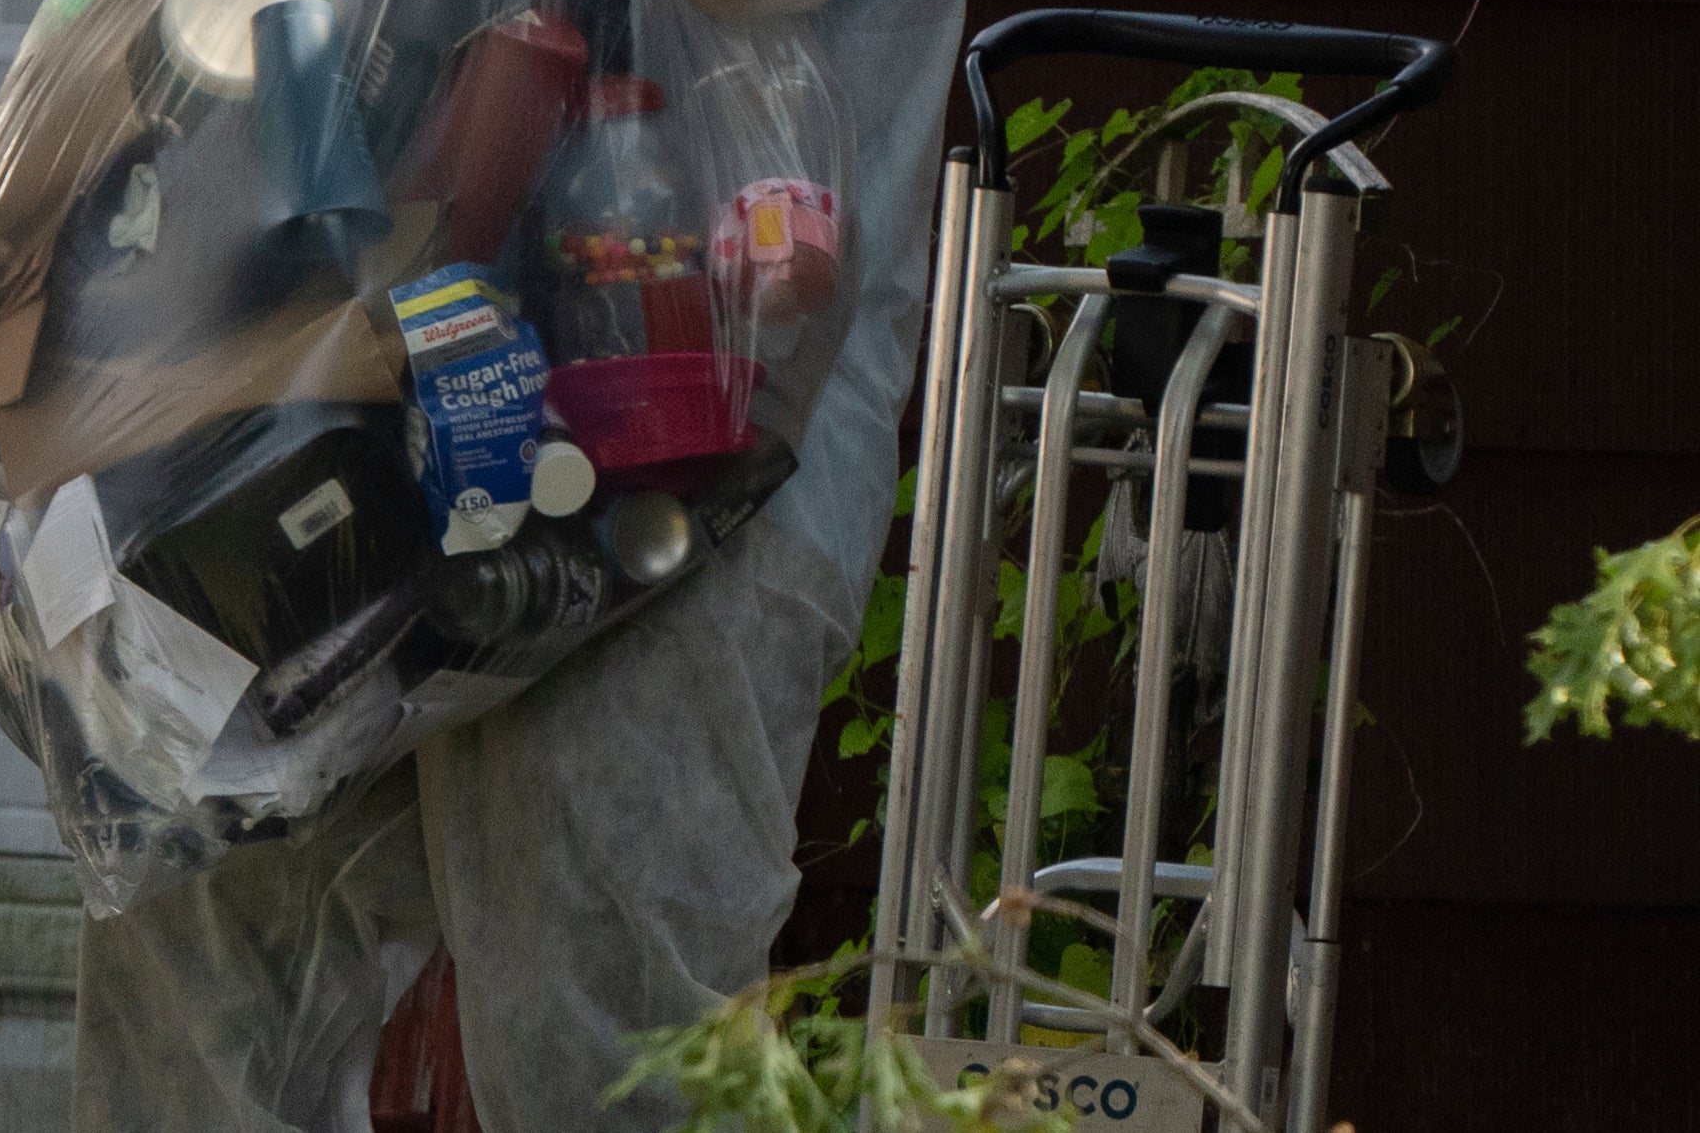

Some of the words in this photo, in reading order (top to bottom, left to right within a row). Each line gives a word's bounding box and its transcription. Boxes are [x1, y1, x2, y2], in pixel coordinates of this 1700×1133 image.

[422, 313, 495, 343] Walgreens
[434, 350, 541, 394] Sugar-Free
[1319, 333, 1336, 429] COSCO
[440, 381, 519, 410] Cough
[459, 495, 490, 511] 150
[957, 1062, 1137, 1120] CSCO
